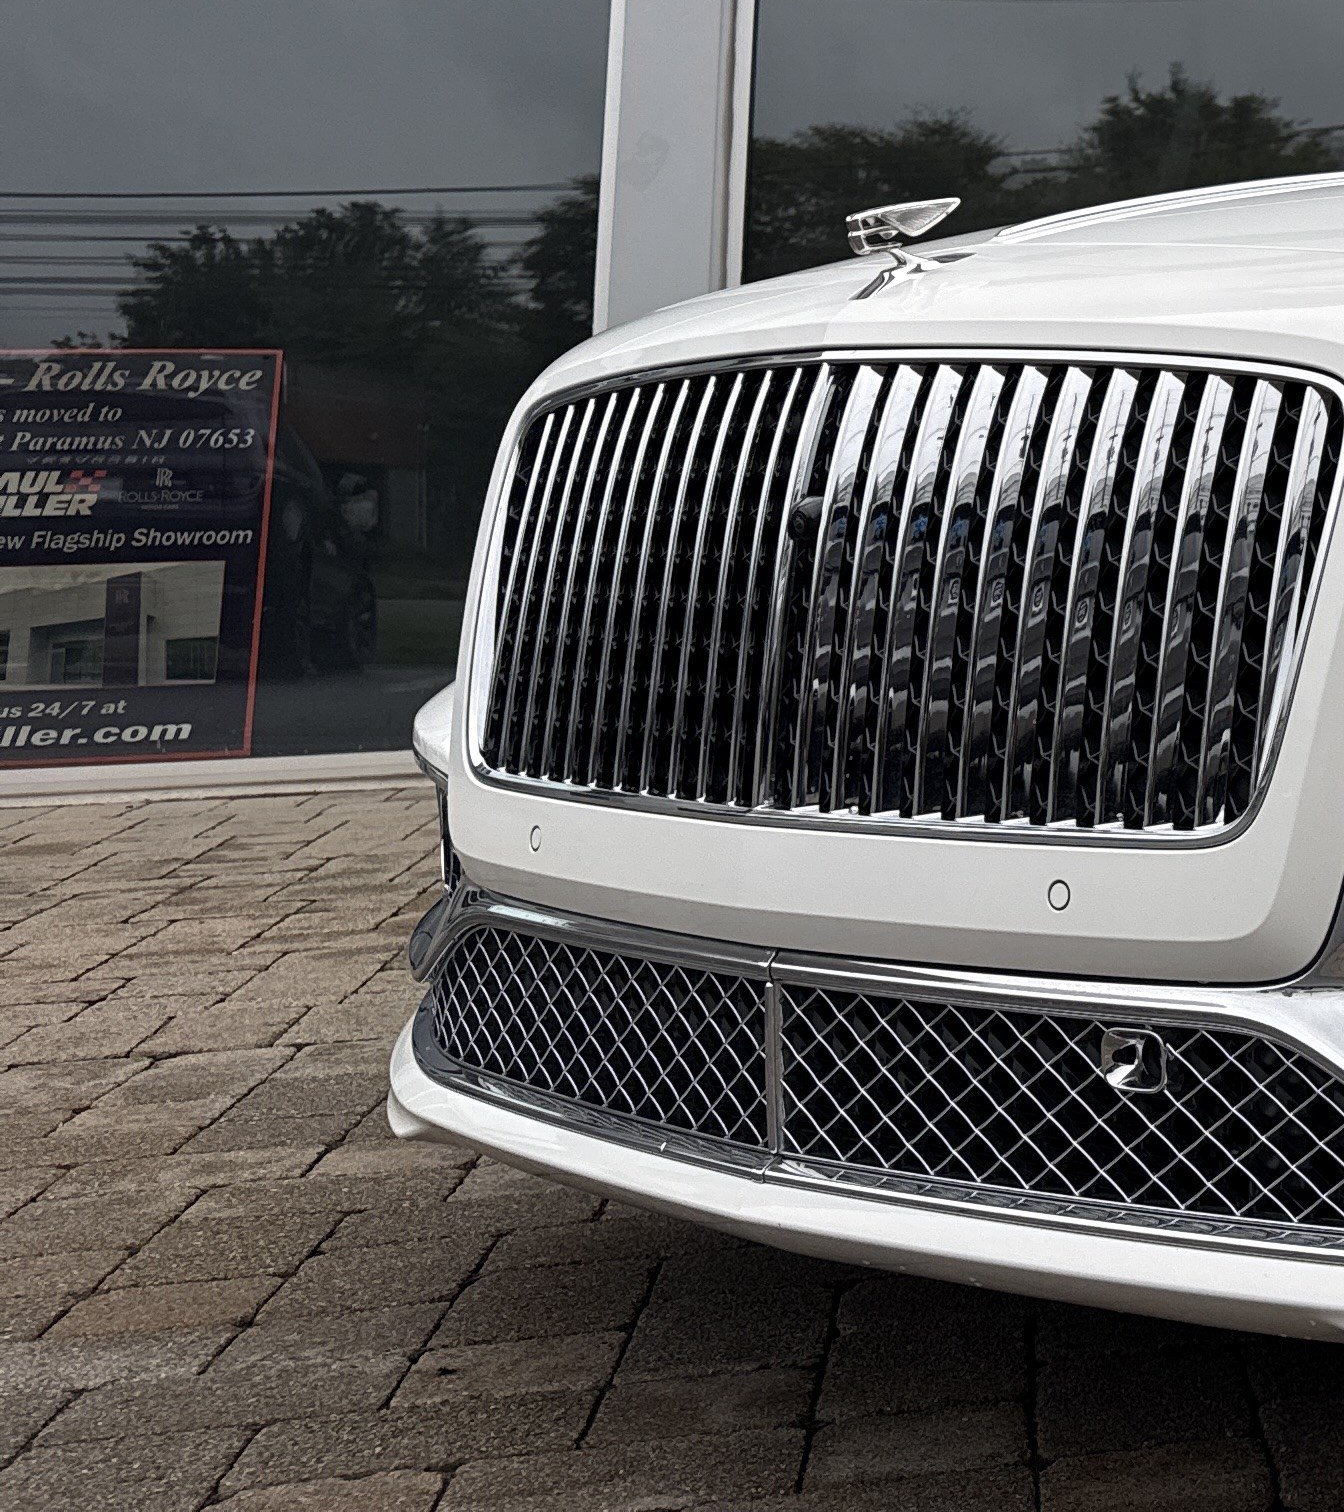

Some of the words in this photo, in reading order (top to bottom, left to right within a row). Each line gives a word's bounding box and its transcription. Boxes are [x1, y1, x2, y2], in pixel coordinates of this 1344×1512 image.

[22, 361, 131, 391] Rolls
[137, 360, 263, 398] Royce
[12, 402, 95, 423] moved
[98, 405, 123, 422] to
[10, 431, 126, 451] Paramus
[132, 429, 174, 450] NJ
[179, 428, 255, 449] 07653
[30, 528, 126, 553] Flagship
[131, 527, 254, 548] Showroom
[28, 700, 96, 719] 24/7
[100, 699, 127, 715] at
[0, 722, 193, 747] ller.com
